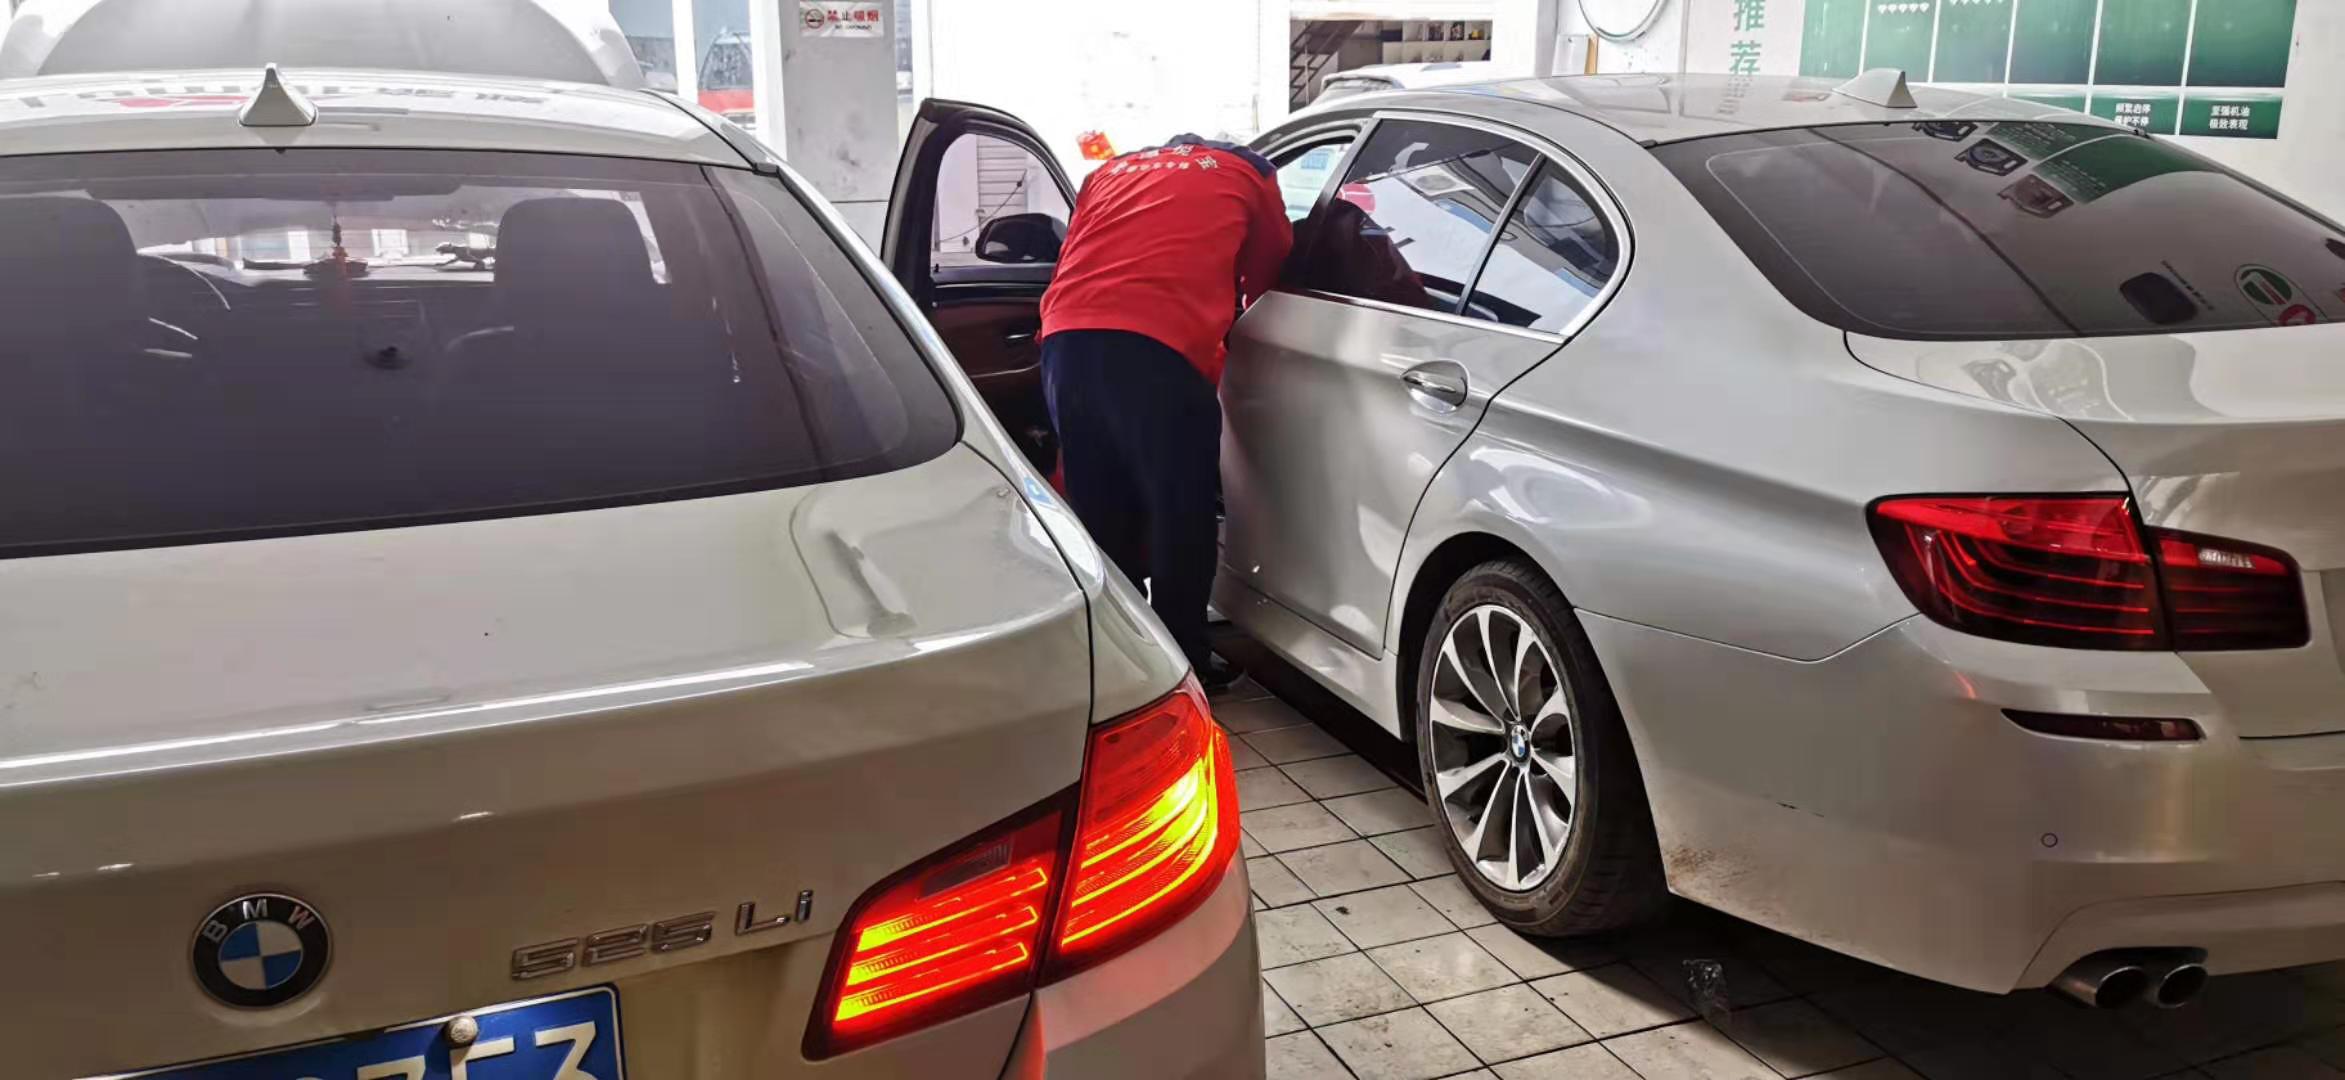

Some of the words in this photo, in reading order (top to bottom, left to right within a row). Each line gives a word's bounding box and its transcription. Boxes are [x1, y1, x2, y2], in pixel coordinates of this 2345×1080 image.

[827, 9, 880, 23] 禁止吸烟
[1729, 0, 1766, 76] 推荐
[202, 898, 316, 943] BMW
[512, 911, 717, 980] 525
[735, 889, 814, 937] Li
